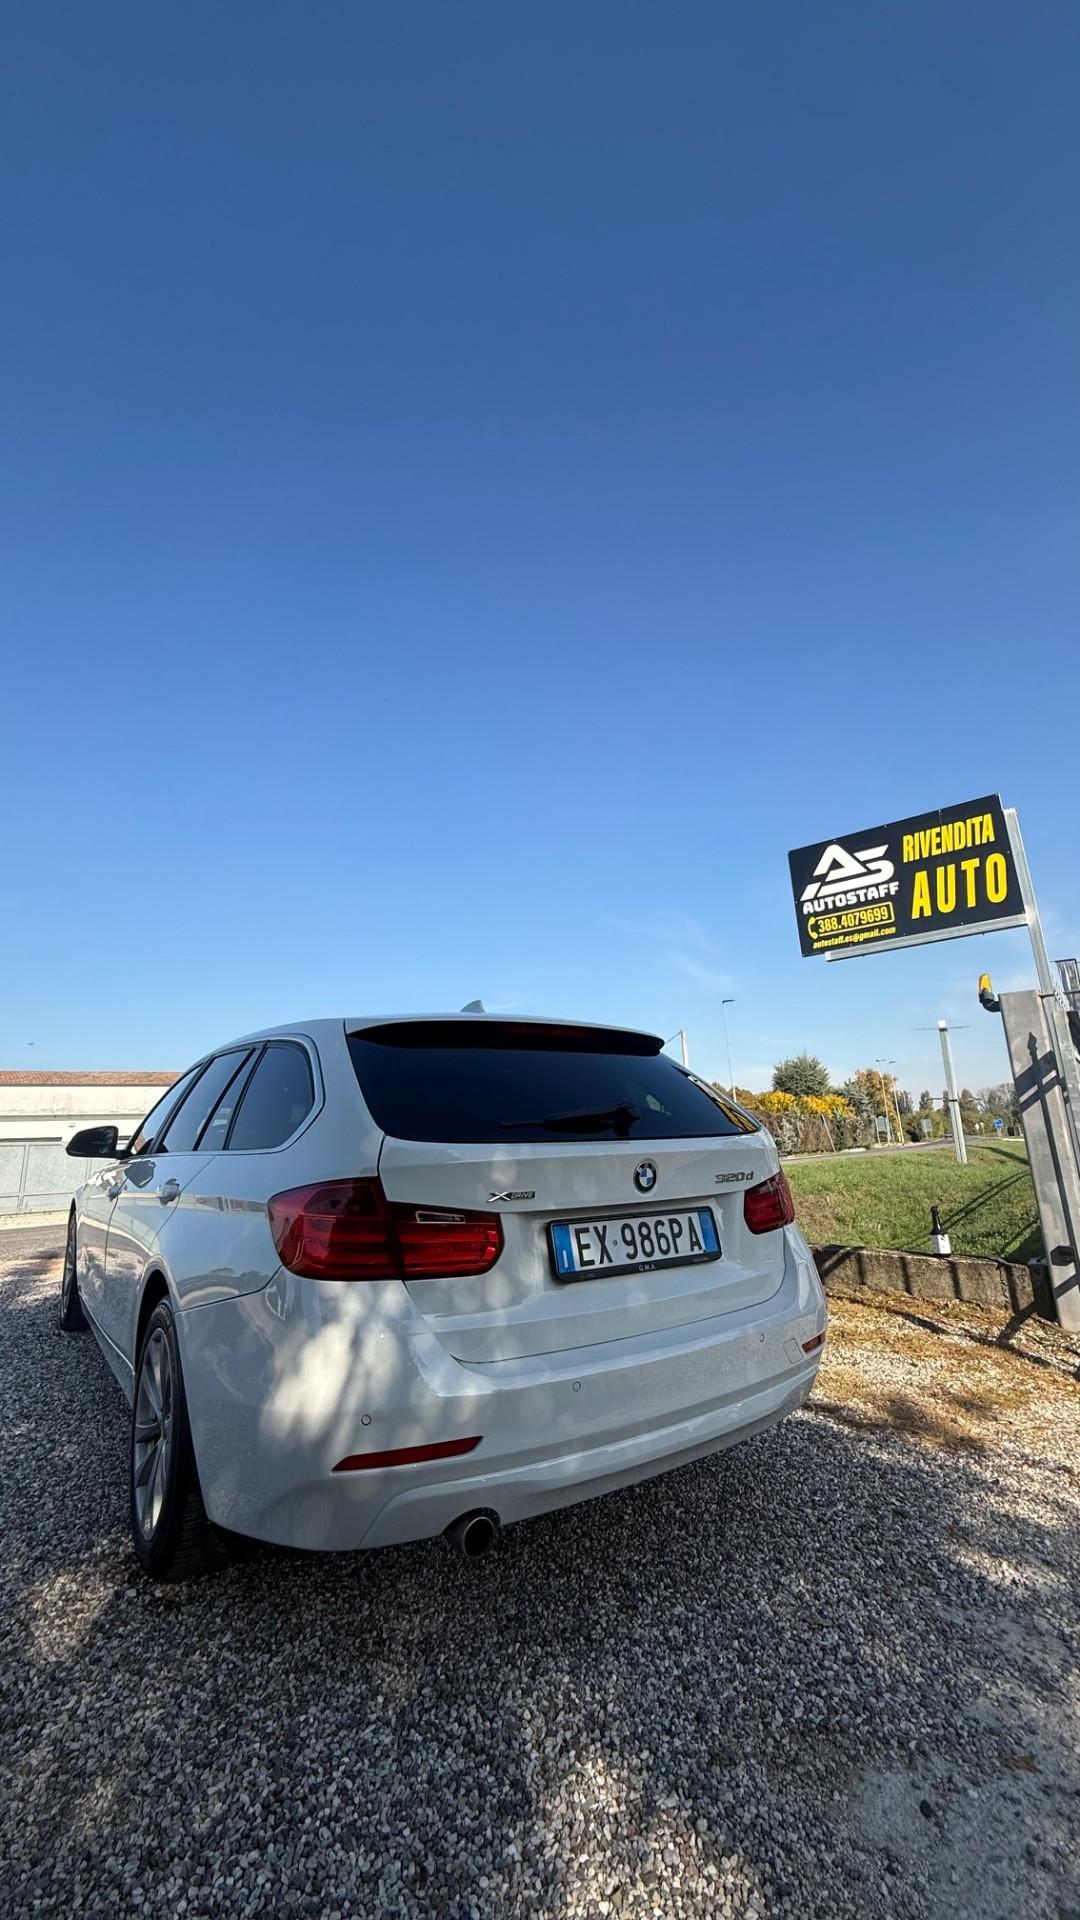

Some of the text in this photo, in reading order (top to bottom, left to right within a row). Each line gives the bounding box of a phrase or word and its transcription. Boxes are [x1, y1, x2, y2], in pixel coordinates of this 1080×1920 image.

[903, 813, 995, 864] RIVENDITA
[803, 882, 899, 915] AUTOSTAFF
[911, 852, 1007, 920] AUTO
[818, 907, 888, 934] 388.4079699
[813, 926, 896, 949] autostaff.es@gmail.com
[714, 1170, 754, 1184] 320d
